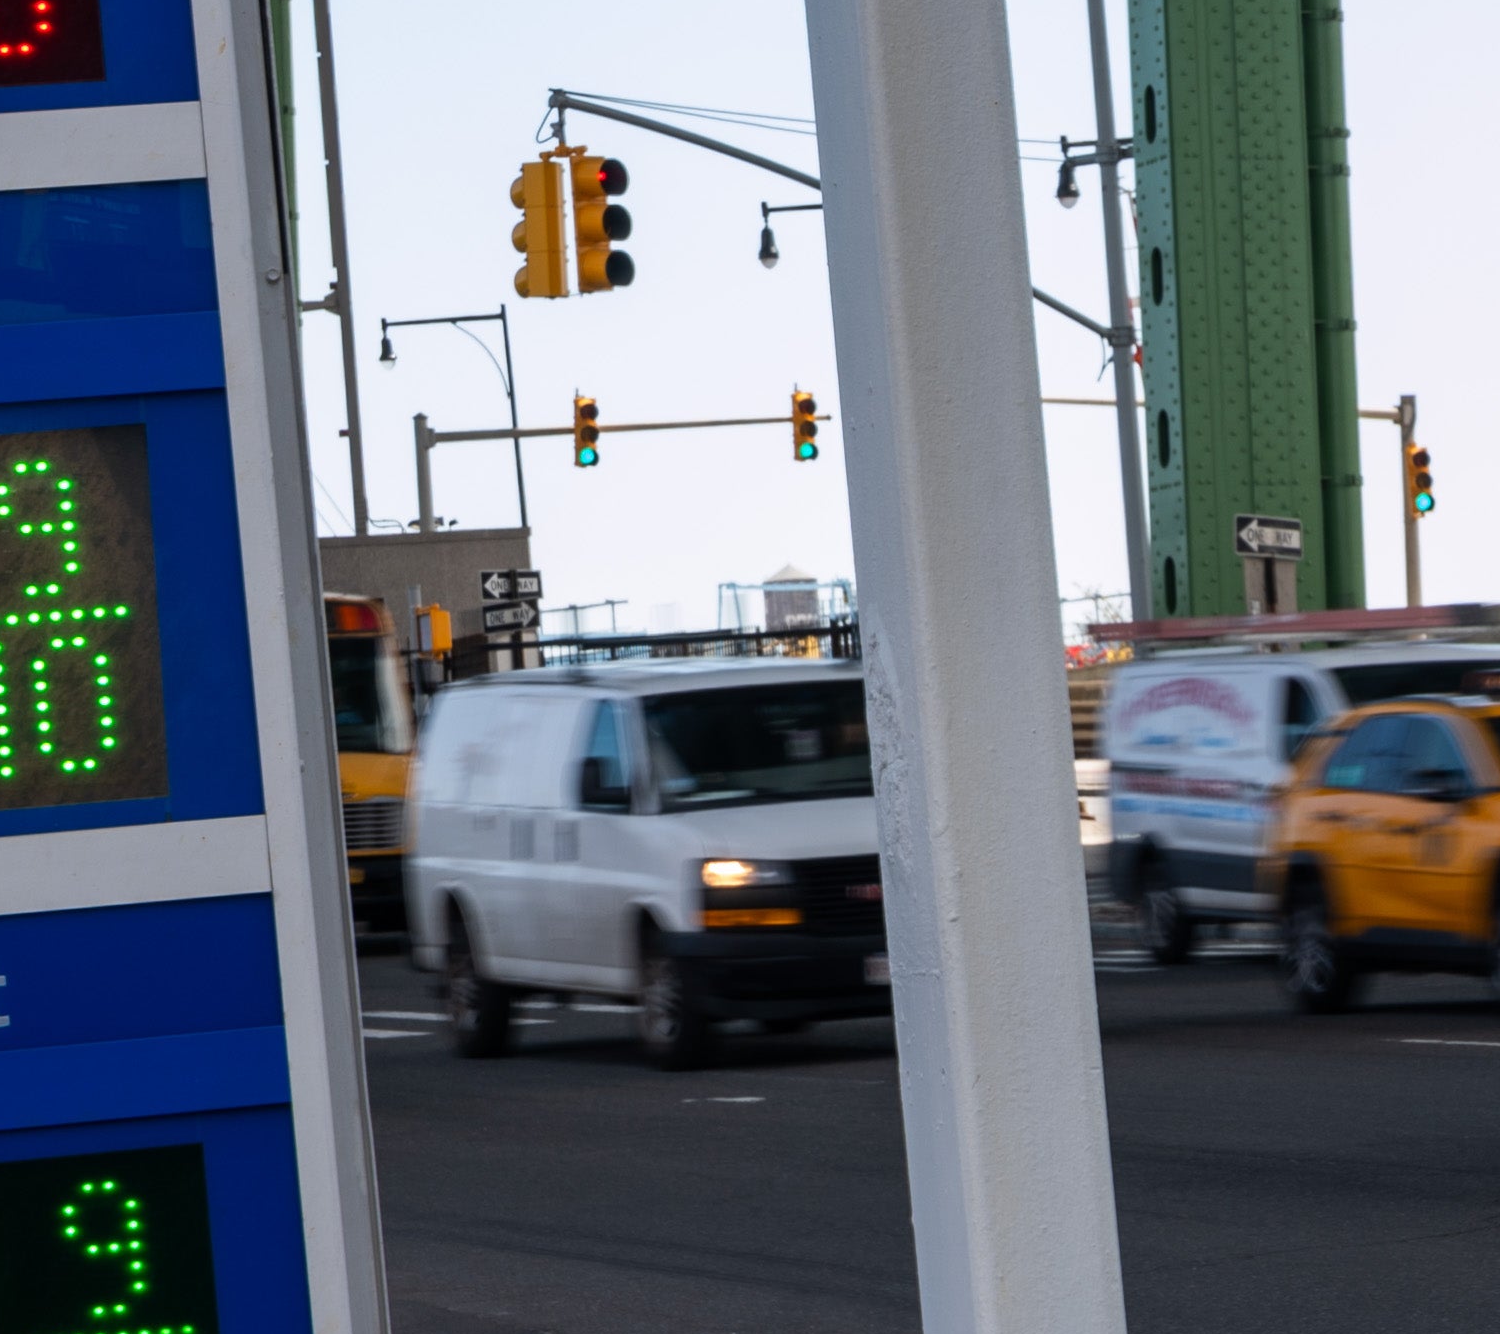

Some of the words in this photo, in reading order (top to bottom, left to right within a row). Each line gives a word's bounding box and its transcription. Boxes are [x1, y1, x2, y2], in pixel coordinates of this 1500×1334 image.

[1247, 528, 1265, 544] ONE
[1275, 531, 1293, 545] WAY
[489, 611, 505, 625] ONE
[513, 608, 531, 621] WAY
